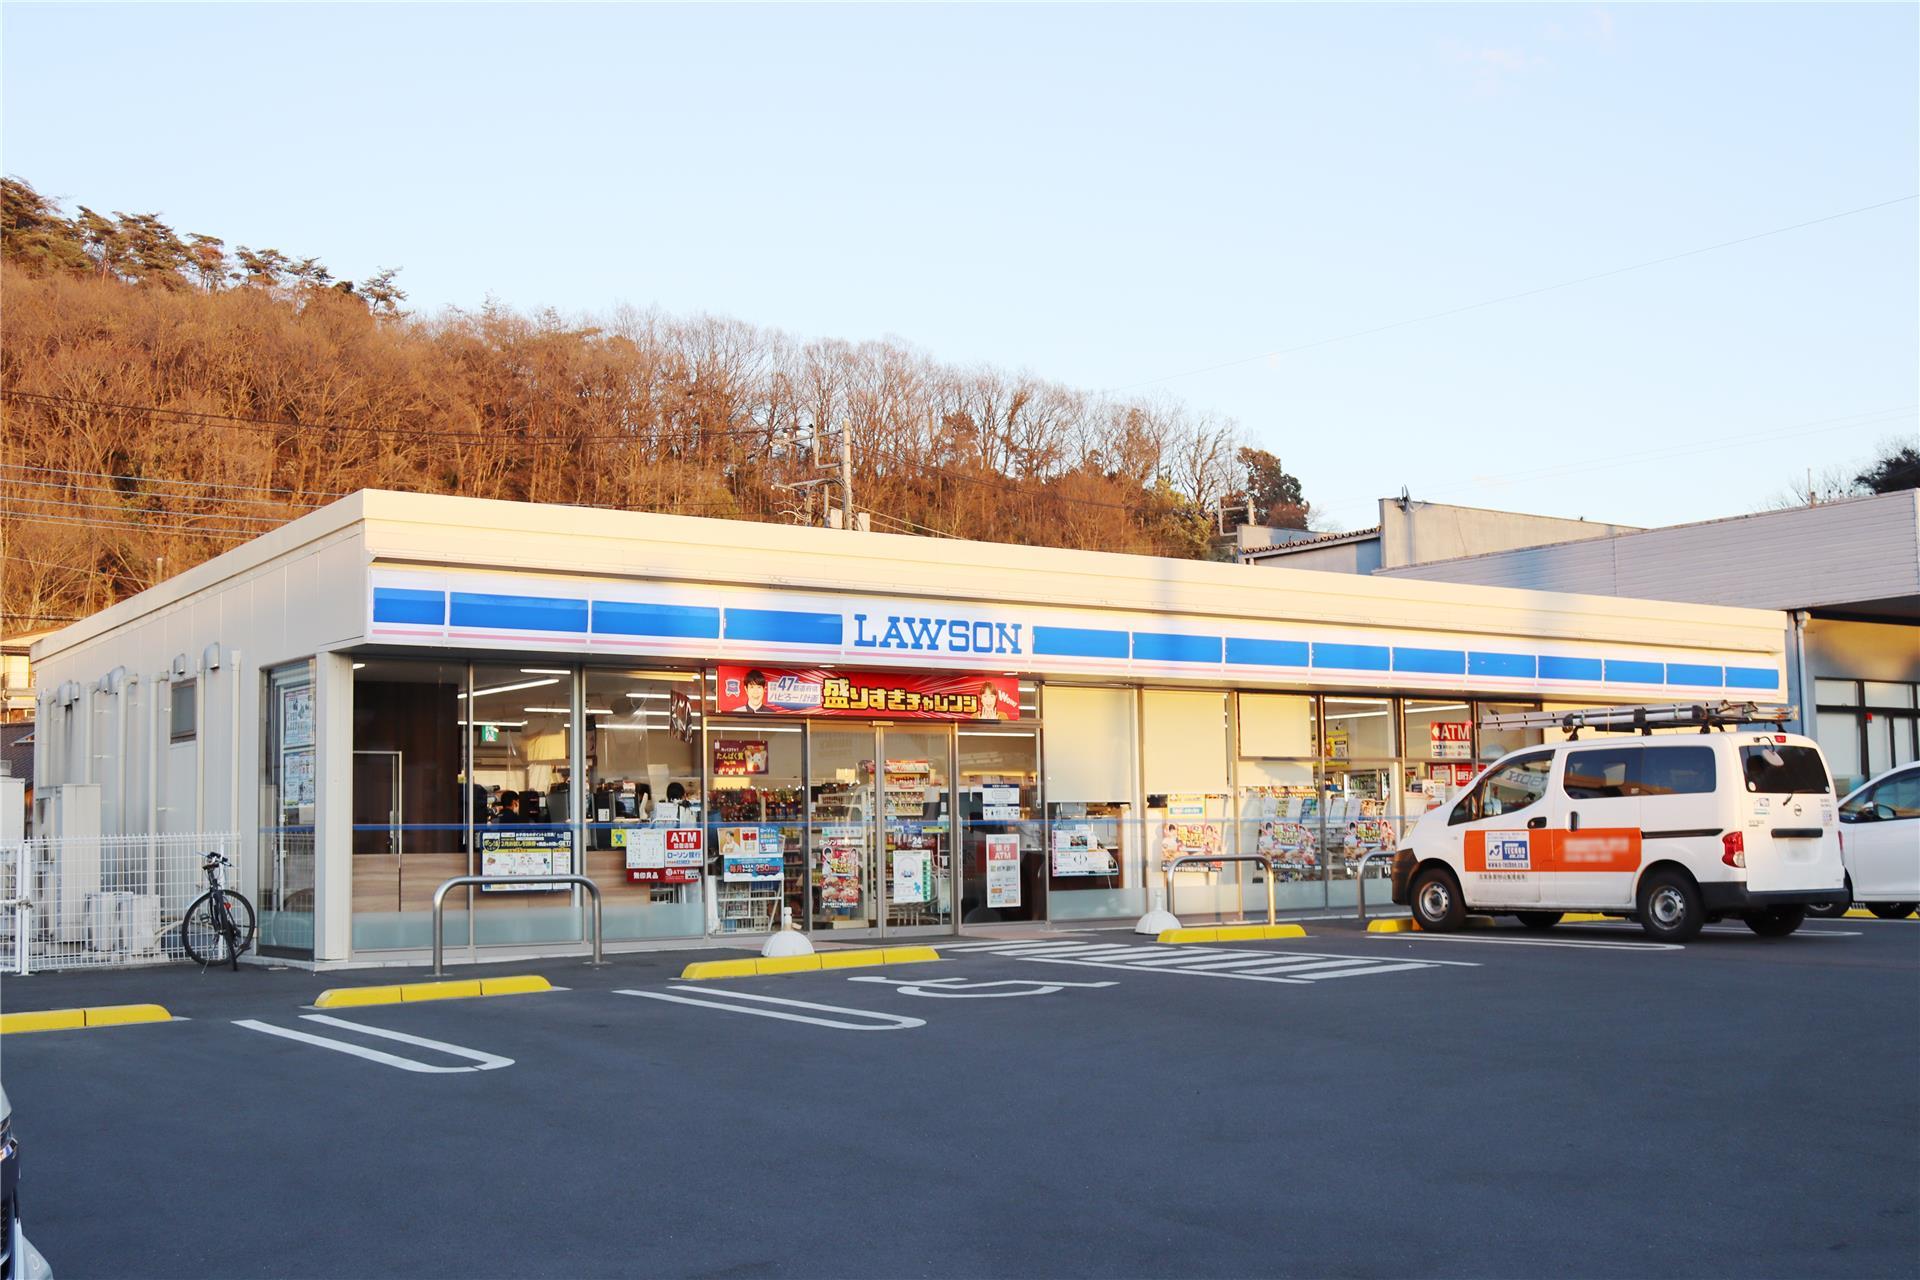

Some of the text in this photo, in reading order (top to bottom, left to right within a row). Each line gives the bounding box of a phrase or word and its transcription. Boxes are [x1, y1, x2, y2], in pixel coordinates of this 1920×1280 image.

[854, 614, 1022, 654] LAWSON
[822, 678, 978, 713] 盛りすぎチャレンジ
[1440, 724, 1470, 740] ATM
[670, 832, 697, 843] ATM
[994, 852, 1011, 860] ATM
